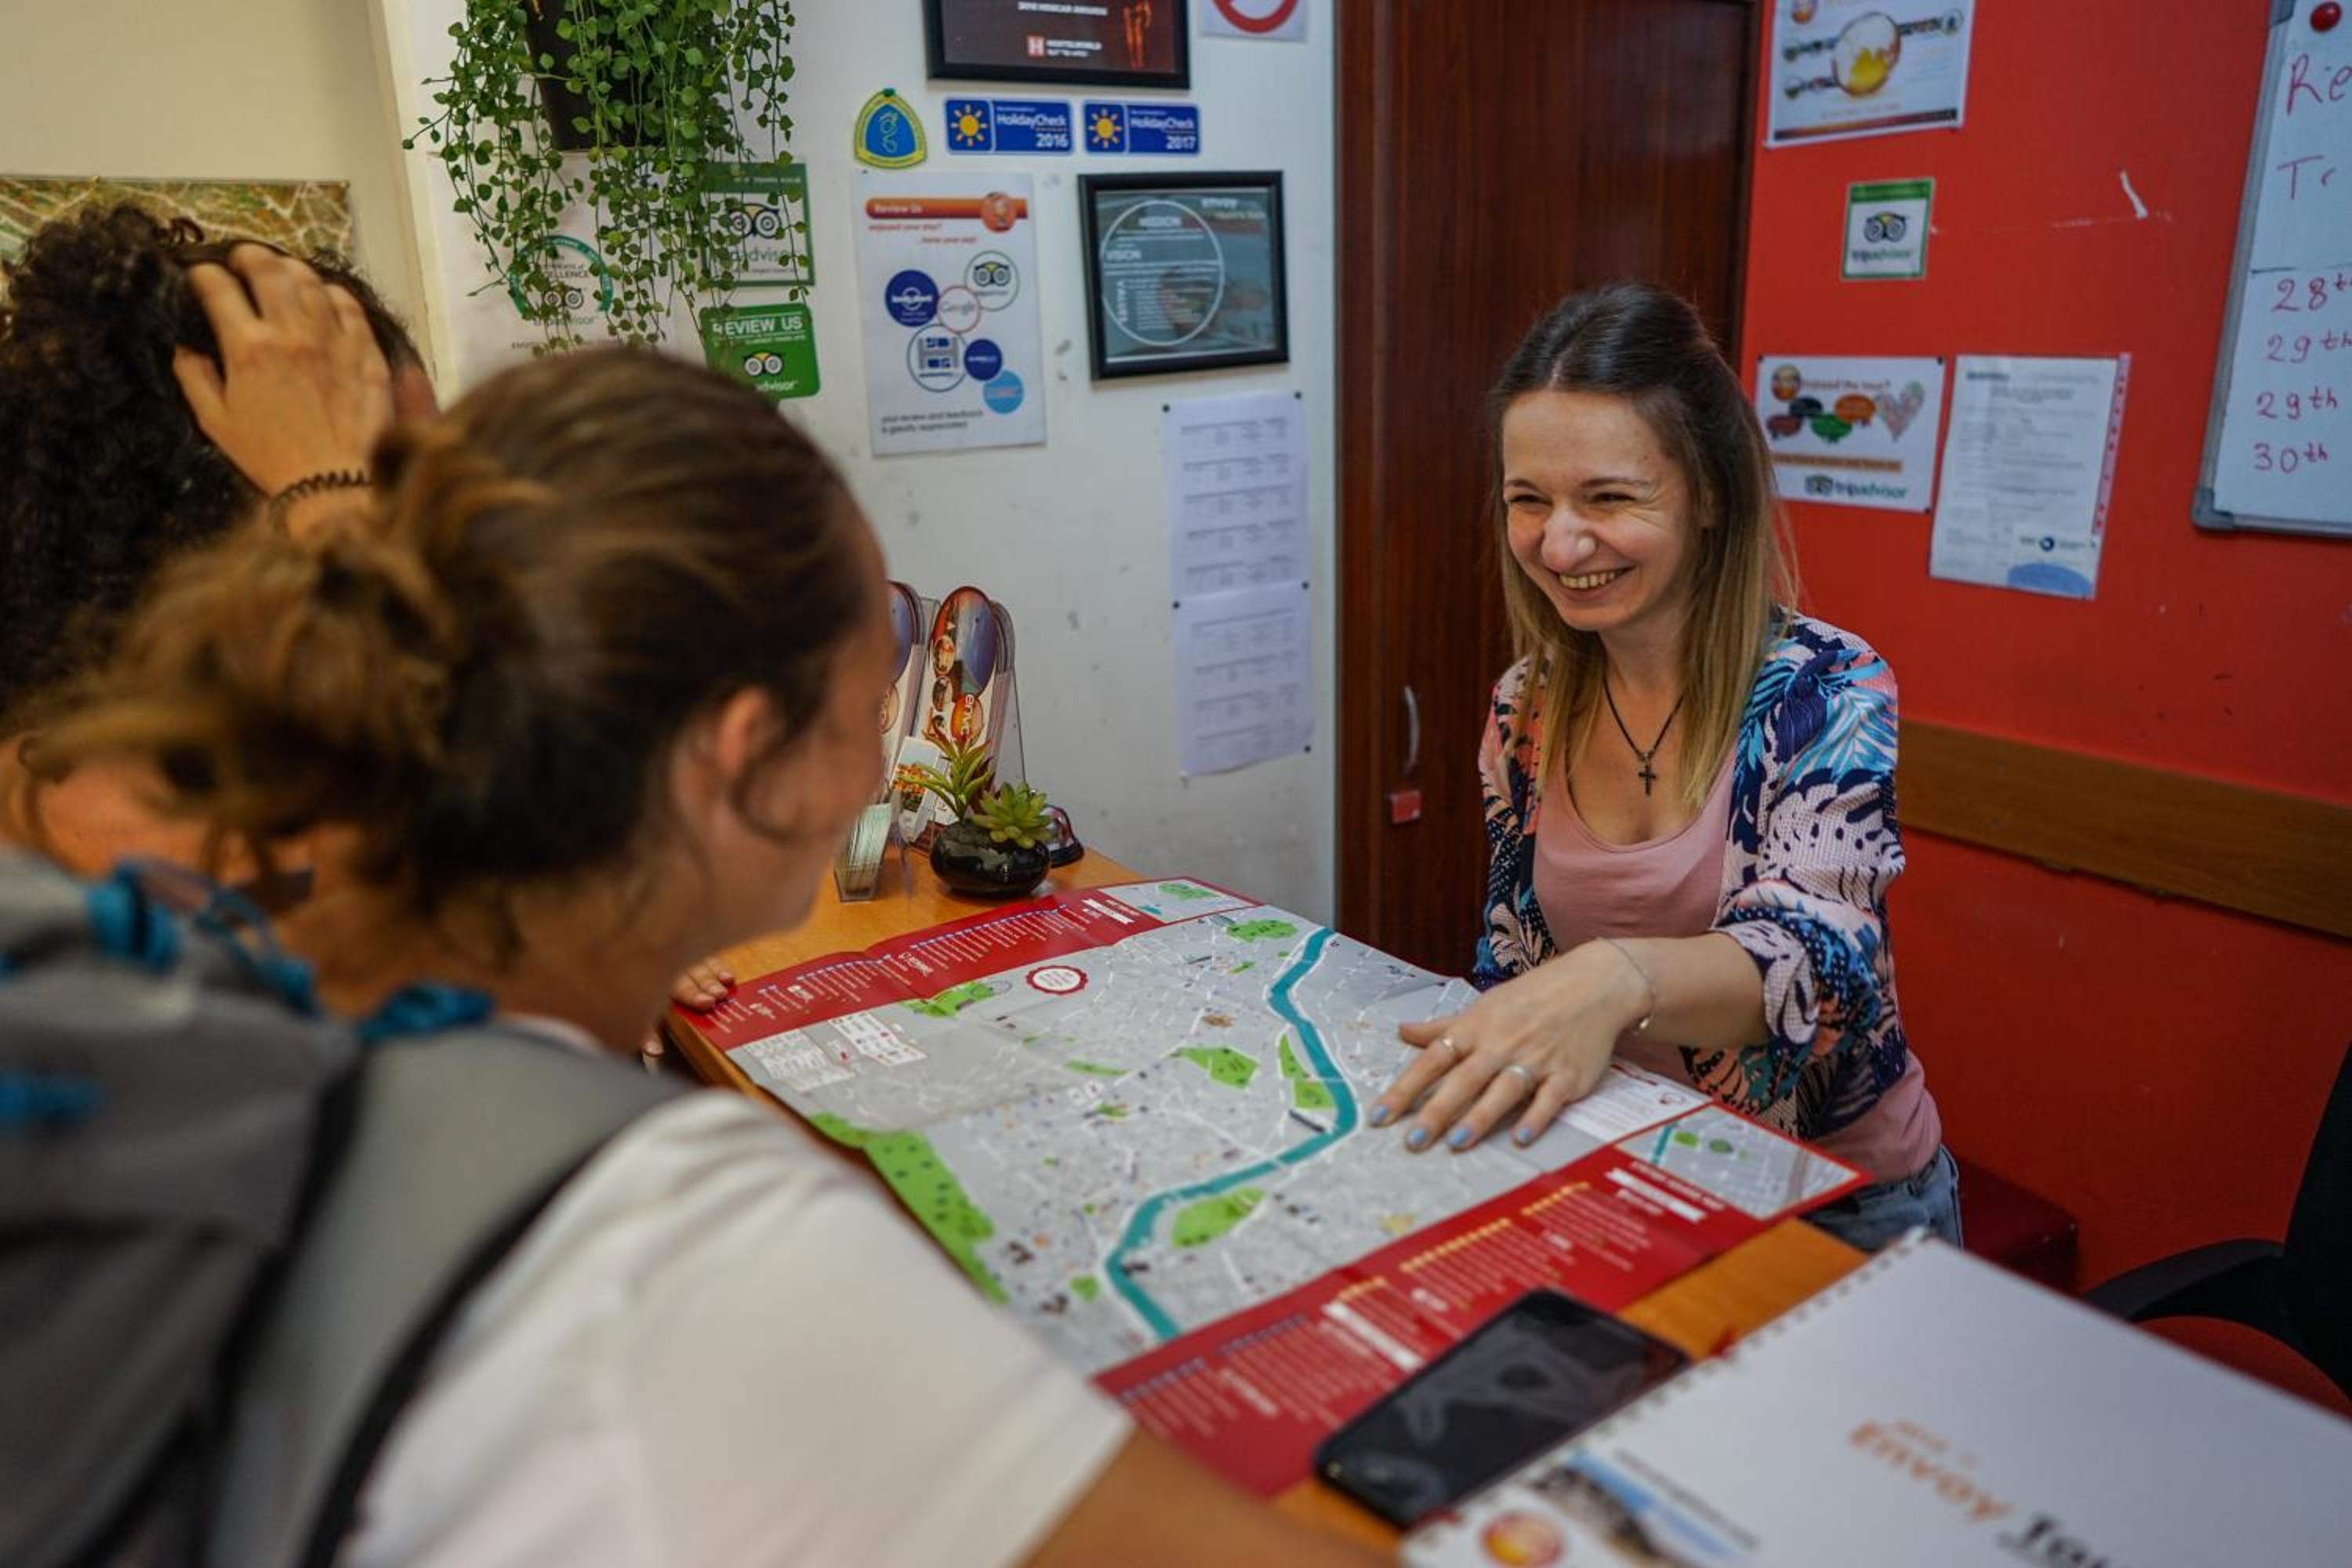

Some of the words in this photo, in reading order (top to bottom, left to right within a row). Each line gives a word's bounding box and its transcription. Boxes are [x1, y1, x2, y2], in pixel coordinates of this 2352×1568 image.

[996, 114, 1066, 129] HolidayCheck
[1131, 117, 1194, 132] HolidayCheck
[1036, 132, 1068, 147] 2016
[1166, 136, 1196, 150] 2017
[2272, 273, 2352, 312] 28t
[781, 316, 803, 330] US
[2256, 386, 2338, 420] 29th
[2252, 442, 2329, 474] 30th
